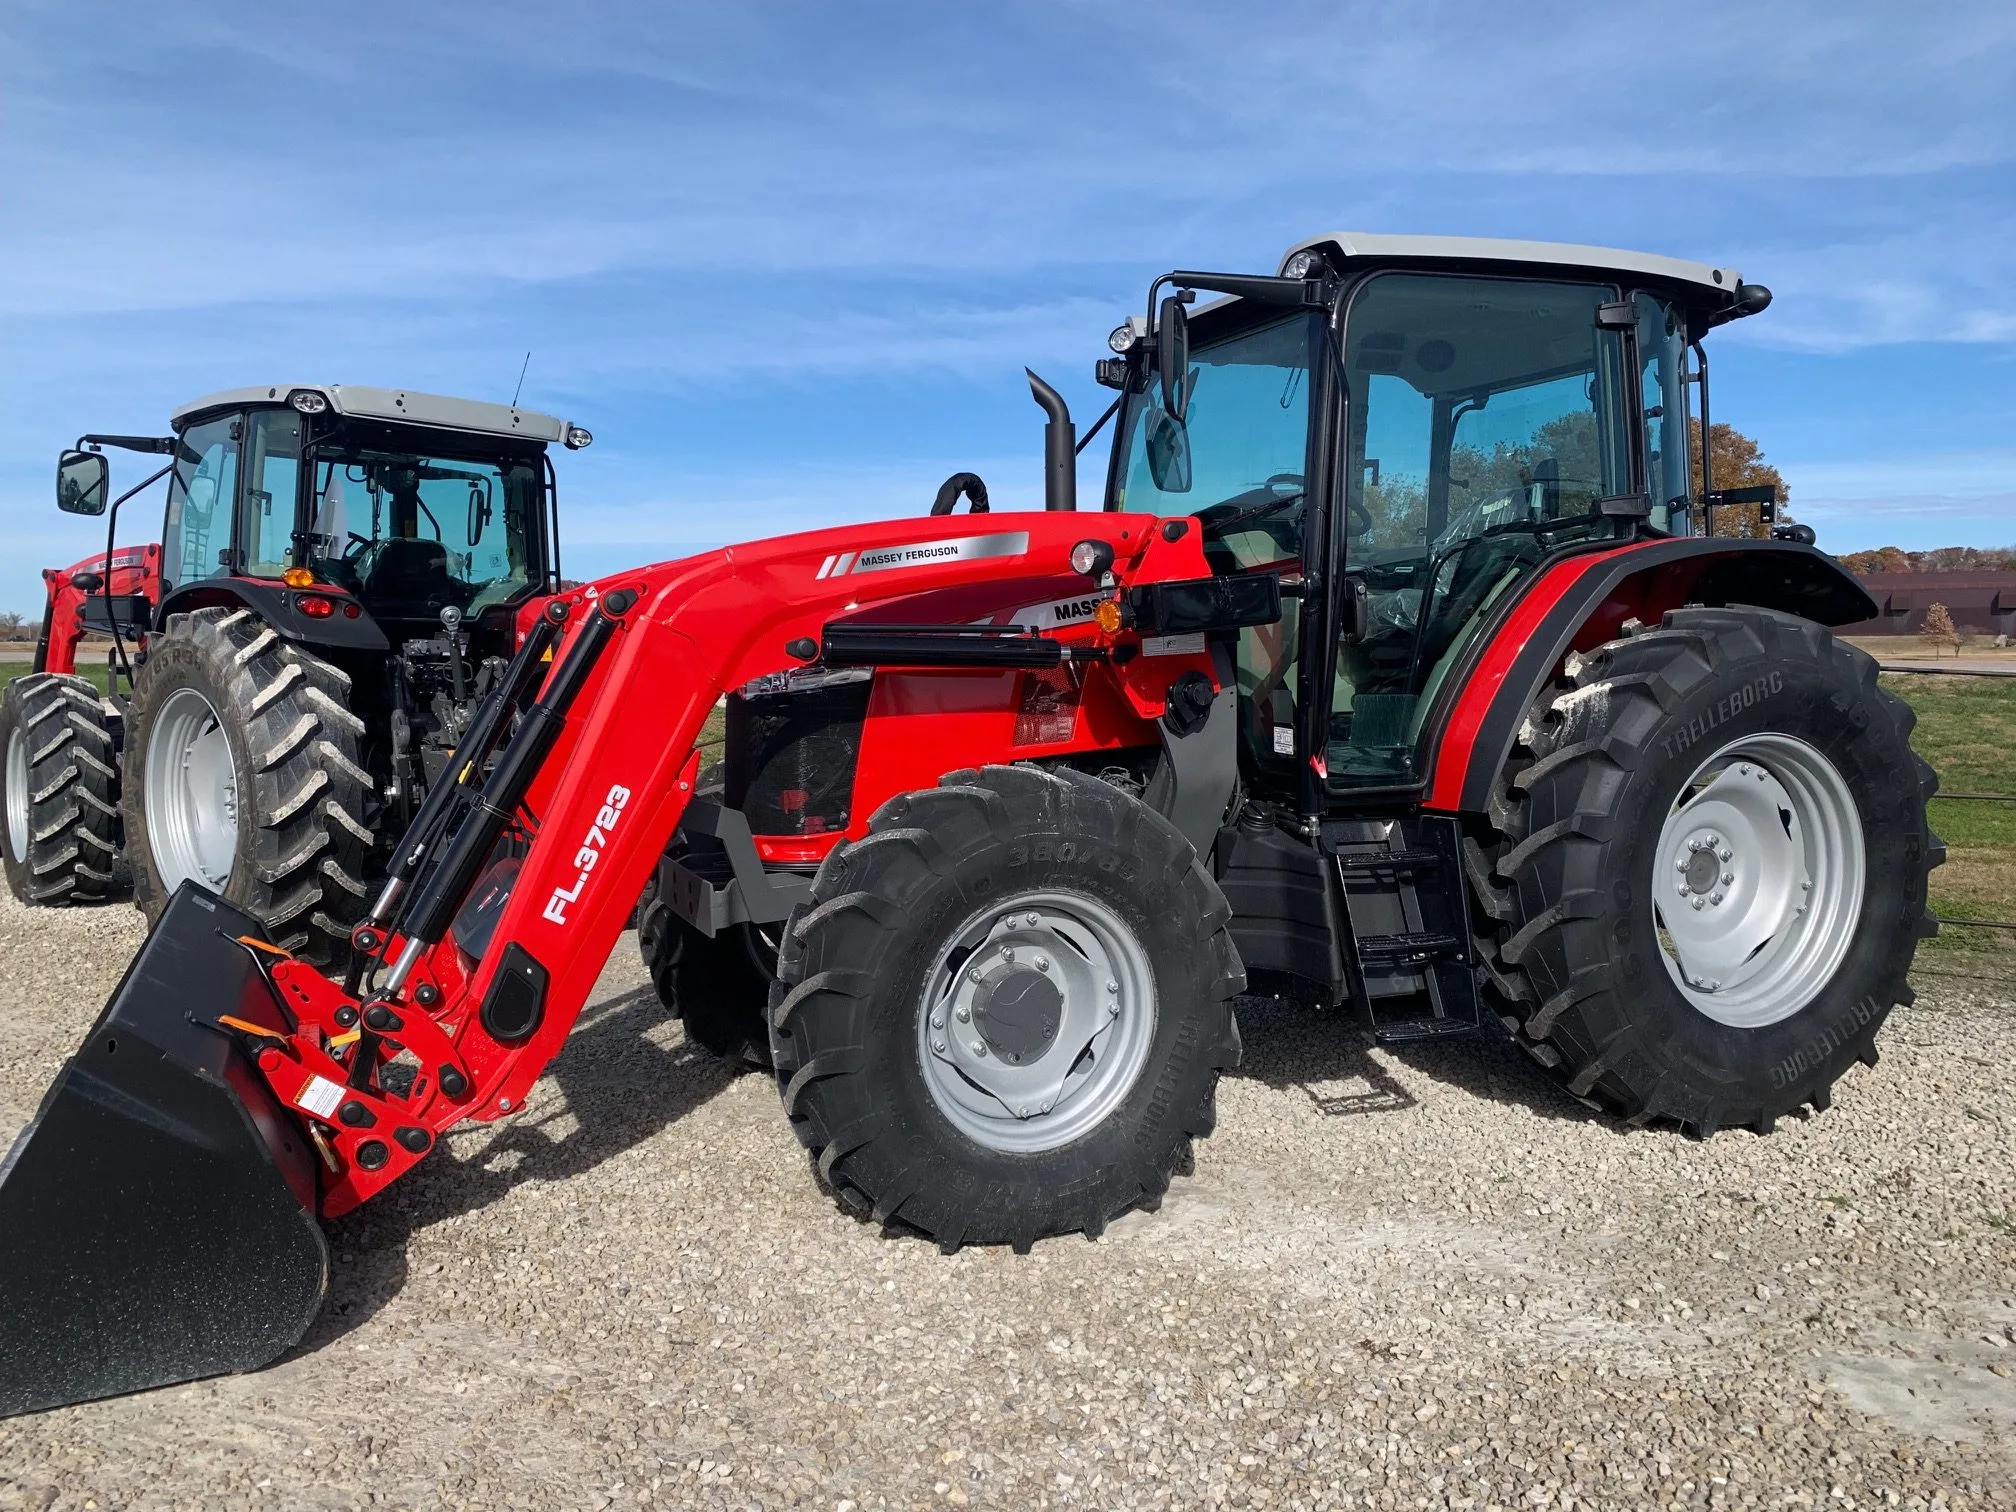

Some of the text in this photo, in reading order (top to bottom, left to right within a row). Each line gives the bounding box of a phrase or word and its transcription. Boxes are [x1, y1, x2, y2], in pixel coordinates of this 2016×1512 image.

[861, 546, 958, 566] MASSEY FERGUSON
[1054, 597, 1114, 620] MASS
[1660, 671, 1783, 760] TRELLEBORG
[542, 784, 631, 925] FL.3723
[1769, 995, 1881, 1090] TRELLEBORG
